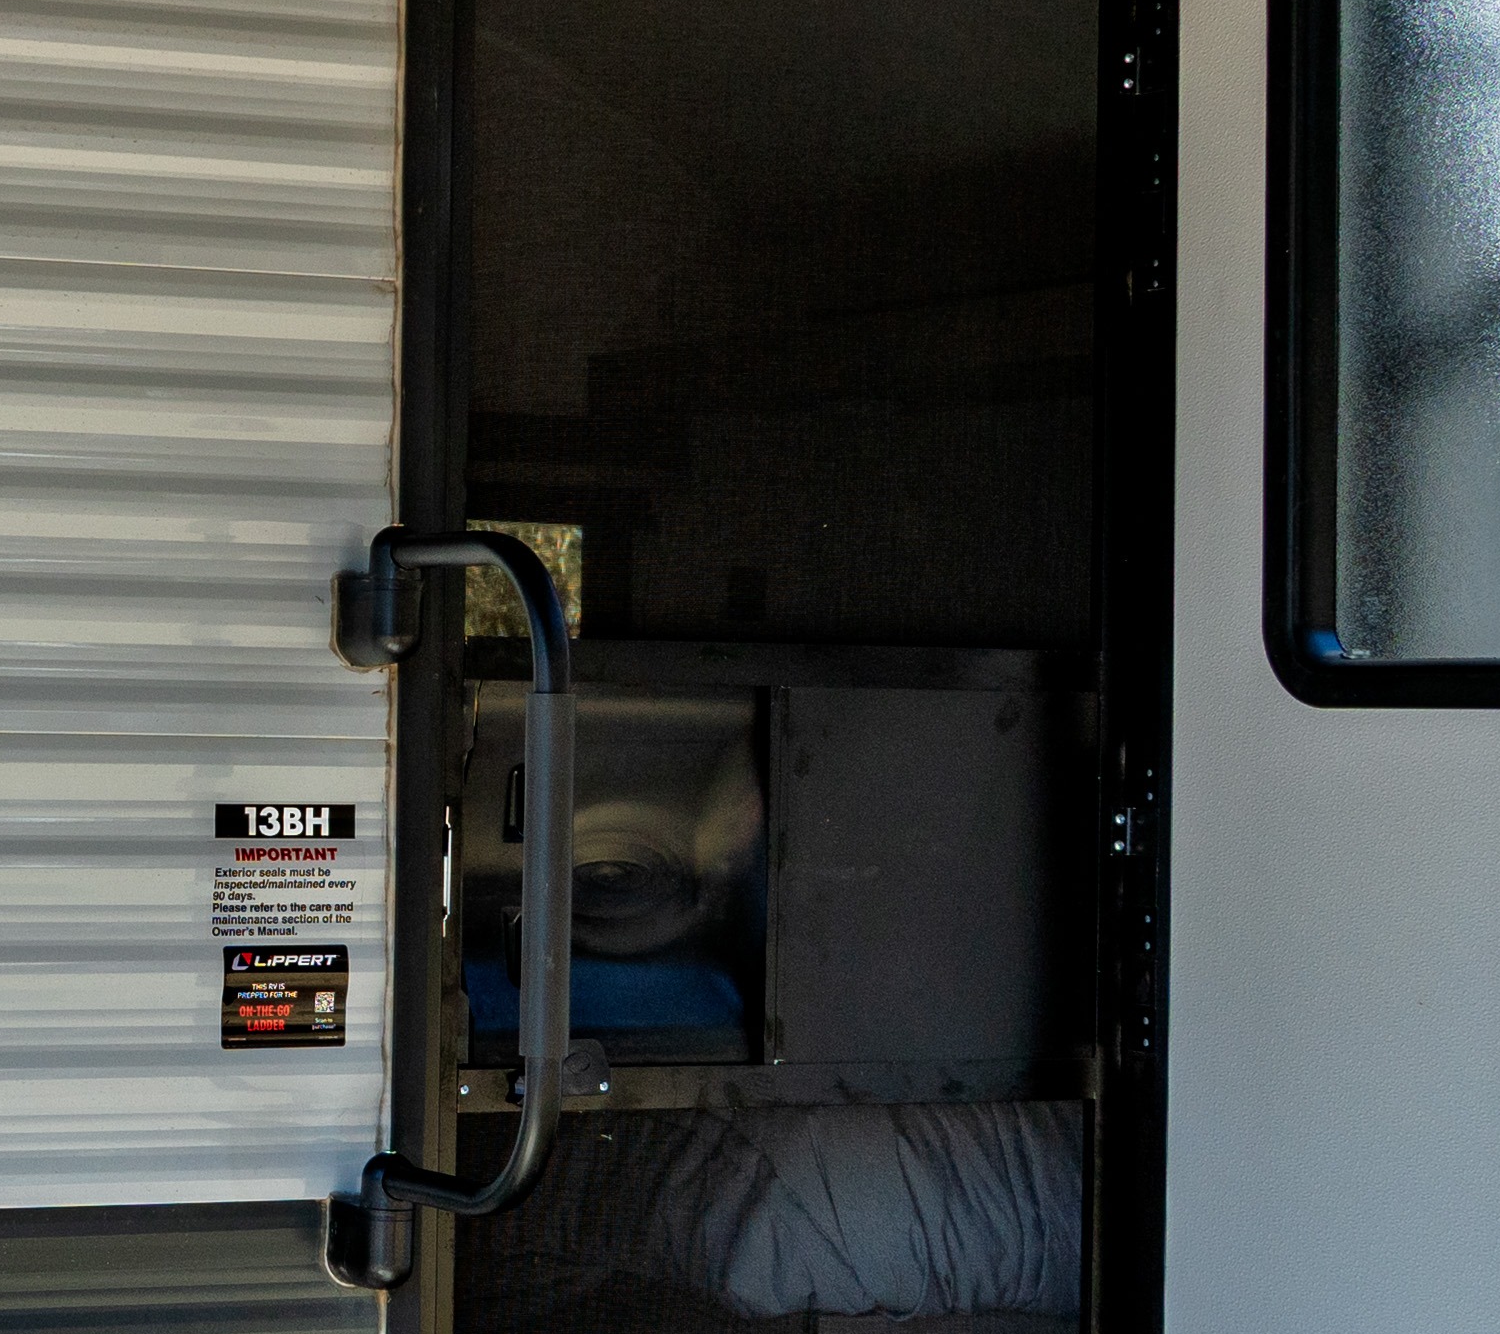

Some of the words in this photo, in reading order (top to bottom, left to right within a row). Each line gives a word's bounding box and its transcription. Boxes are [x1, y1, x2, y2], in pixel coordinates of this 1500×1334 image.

[244, 806, 330, 837] 13BH
[235, 848, 338, 861] IMPORTANT
[215, 867, 257, 877] Exterior
[259, 867, 286, 877] seals
[290, 868, 315, 877] must
[318, 867, 331, 877] be
[214, 879, 325, 891] inspected/maintained
[328, 880, 356, 890] every
[212, 891, 225, 901] 90
[228, 891, 256, 902] days.
[212, 903, 247, 913] Please
[250, 903, 274, 912] refer
[277, 903, 287, 912] to
[290, 903, 306, 912] the
[334, 902, 354, 911] and
[212, 914, 279, 924] maintenance
[281, 914, 319, 924] section
[322, 914, 333, 923] of
[336, 914, 351, 923] the
[212, 927, 254, 936] Owner's
[257, 926, 298, 936] Manual.
[237, 991, 268, 999] PREPPED
[247, 1020, 285, 1031] LADDER
